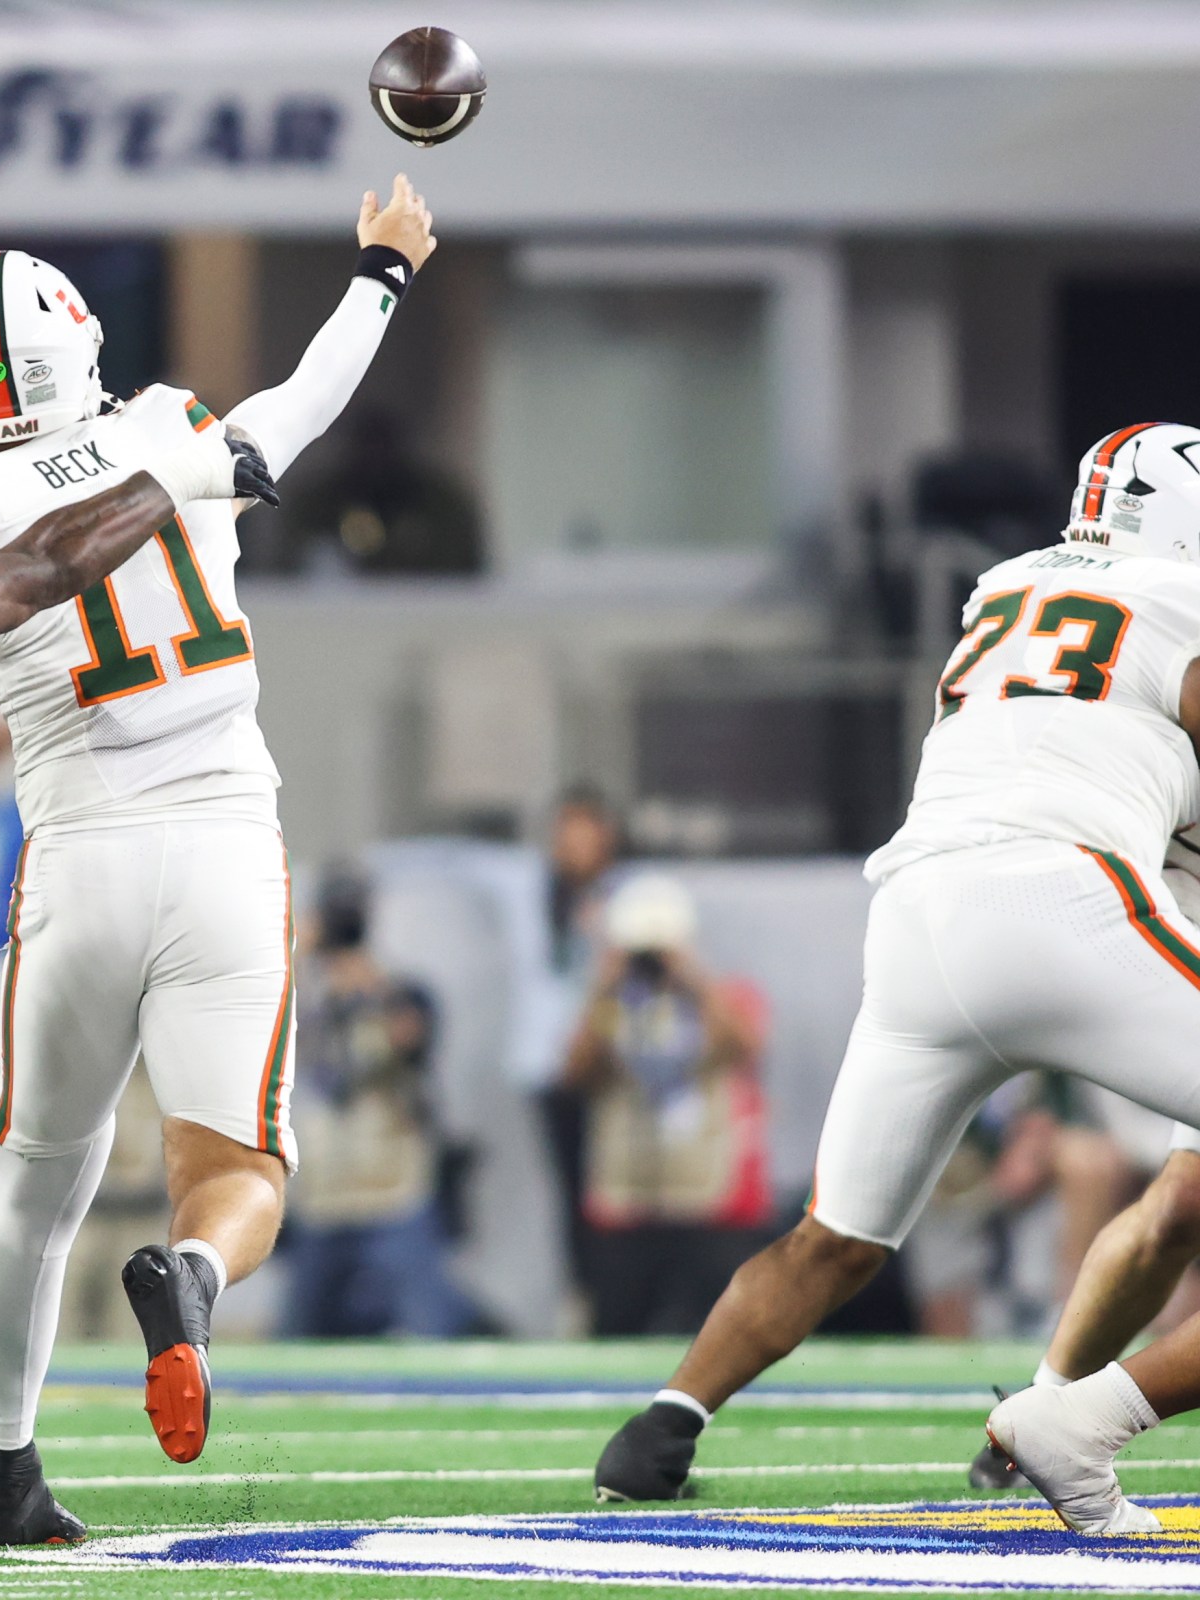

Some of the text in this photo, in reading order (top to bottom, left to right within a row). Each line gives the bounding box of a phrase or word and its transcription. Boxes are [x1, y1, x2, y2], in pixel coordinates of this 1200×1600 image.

[27, 367, 48, 380] ACC
[33, 440, 118, 489] BECK
[1069, 528, 1111, 546] MIAMI
[69, 513, 254, 708] 11
[935, 585, 1133, 725] 73
